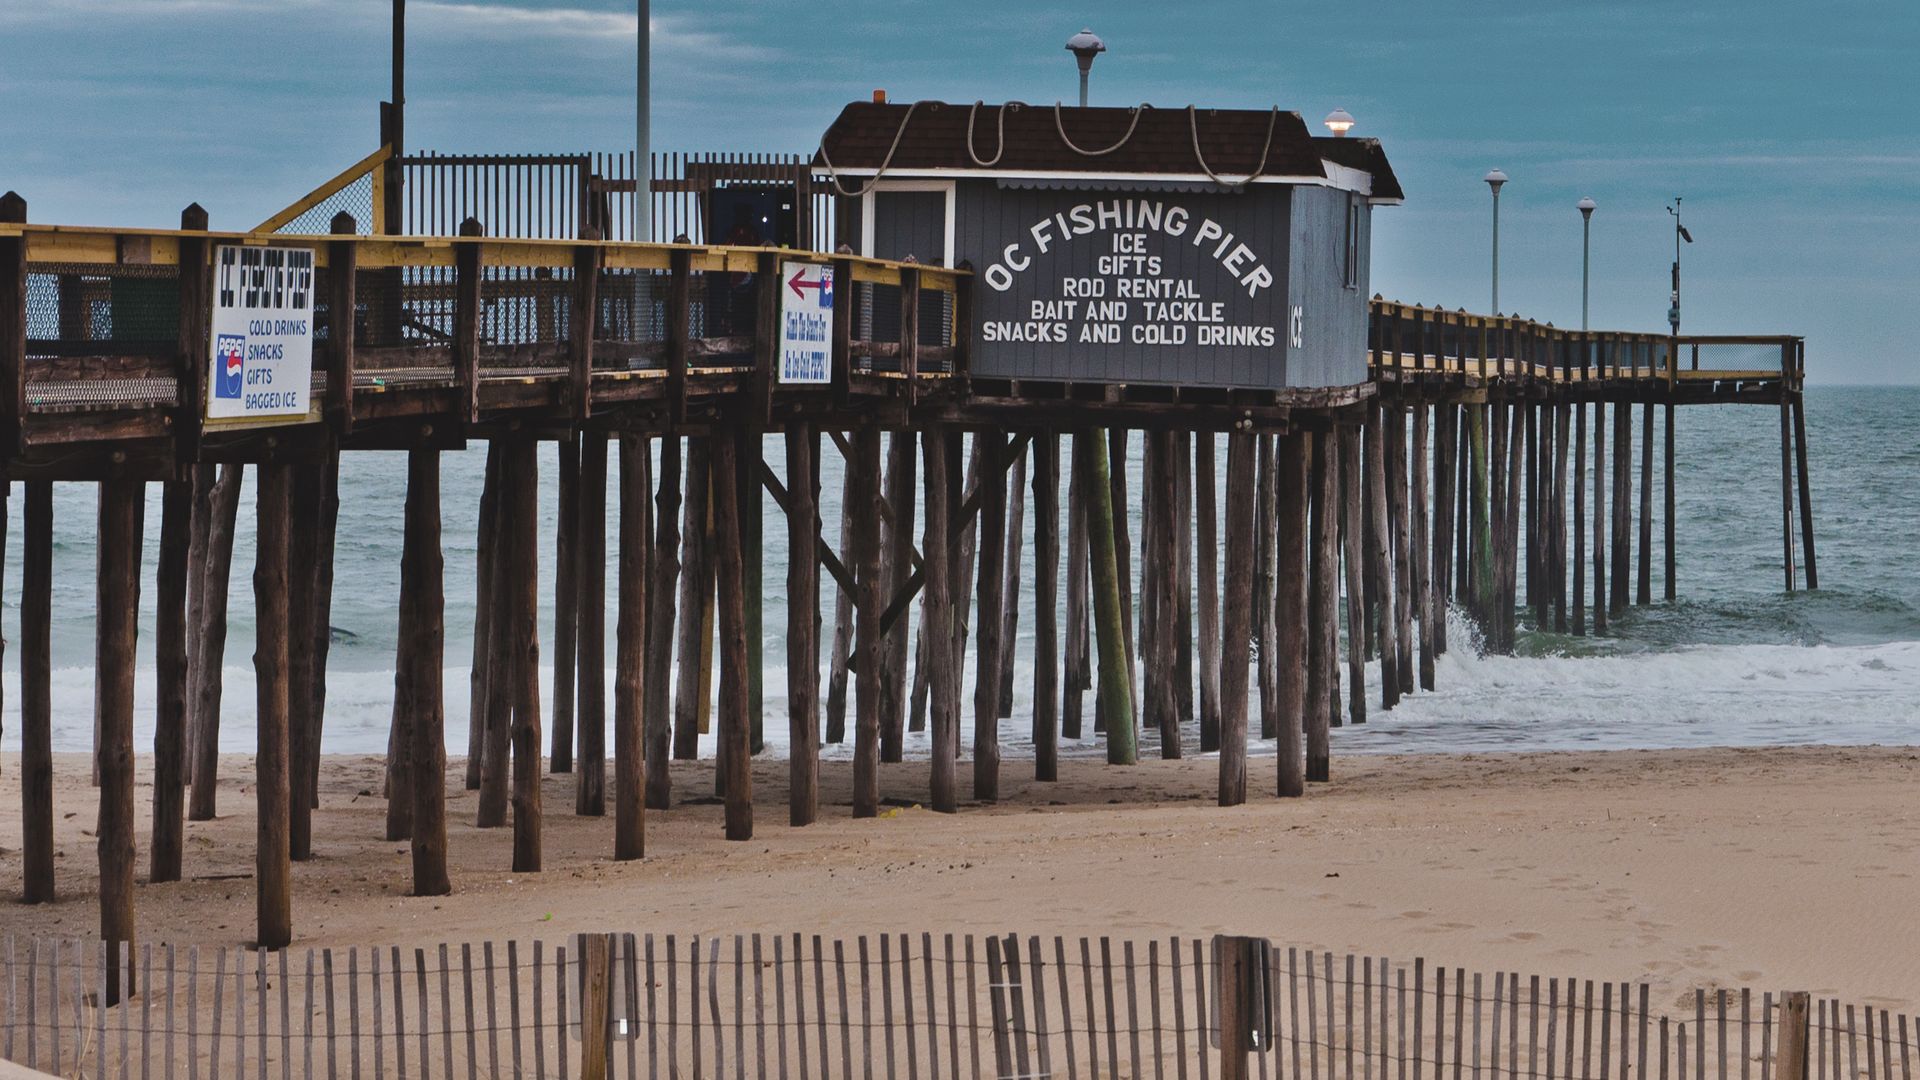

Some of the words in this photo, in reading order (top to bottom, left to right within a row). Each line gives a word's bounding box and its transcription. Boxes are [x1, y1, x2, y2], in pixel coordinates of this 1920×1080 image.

[984, 243, 1031, 292] OC
[1030, 199, 1190, 254] FISHING
[1193, 218, 1273, 298] PIER
[1113, 233, 1147, 254] ICE
[1098, 256, 1162, 276] GIFTS
[220, 247, 235, 308] OC
[239, 248, 284, 309] FISHING
[286, 250, 311, 310] PIER
[1063, 278, 1105, 298] ROD
[1117, 278, 1201, 299] RENTAL
[1031, 300, 1077, 321] BAIT
[1085, 301, 1128, 322] AND
[1143, 302, 1225, 322] TACKLE
[249, 320, 272, 336] COLD
[274, 319, 307, 336] DRINKS
[983, 321, 1068, 343] SNACKS
[1079, 323, 1122, 344] AND
[1131, 324, 1187, 345] COLD
[1197, 326, 1275, 347] DRINKS
[1289, 305, 1303, 349] ICE
[218, 338, 244, 358] PEPSI
[248, 344, 283, 360] SNACKS
[247, 368, 272, 385] GIFTS
[245, 392, 281, 410] BAGGED
[283, 391, 296, 408] ICE
